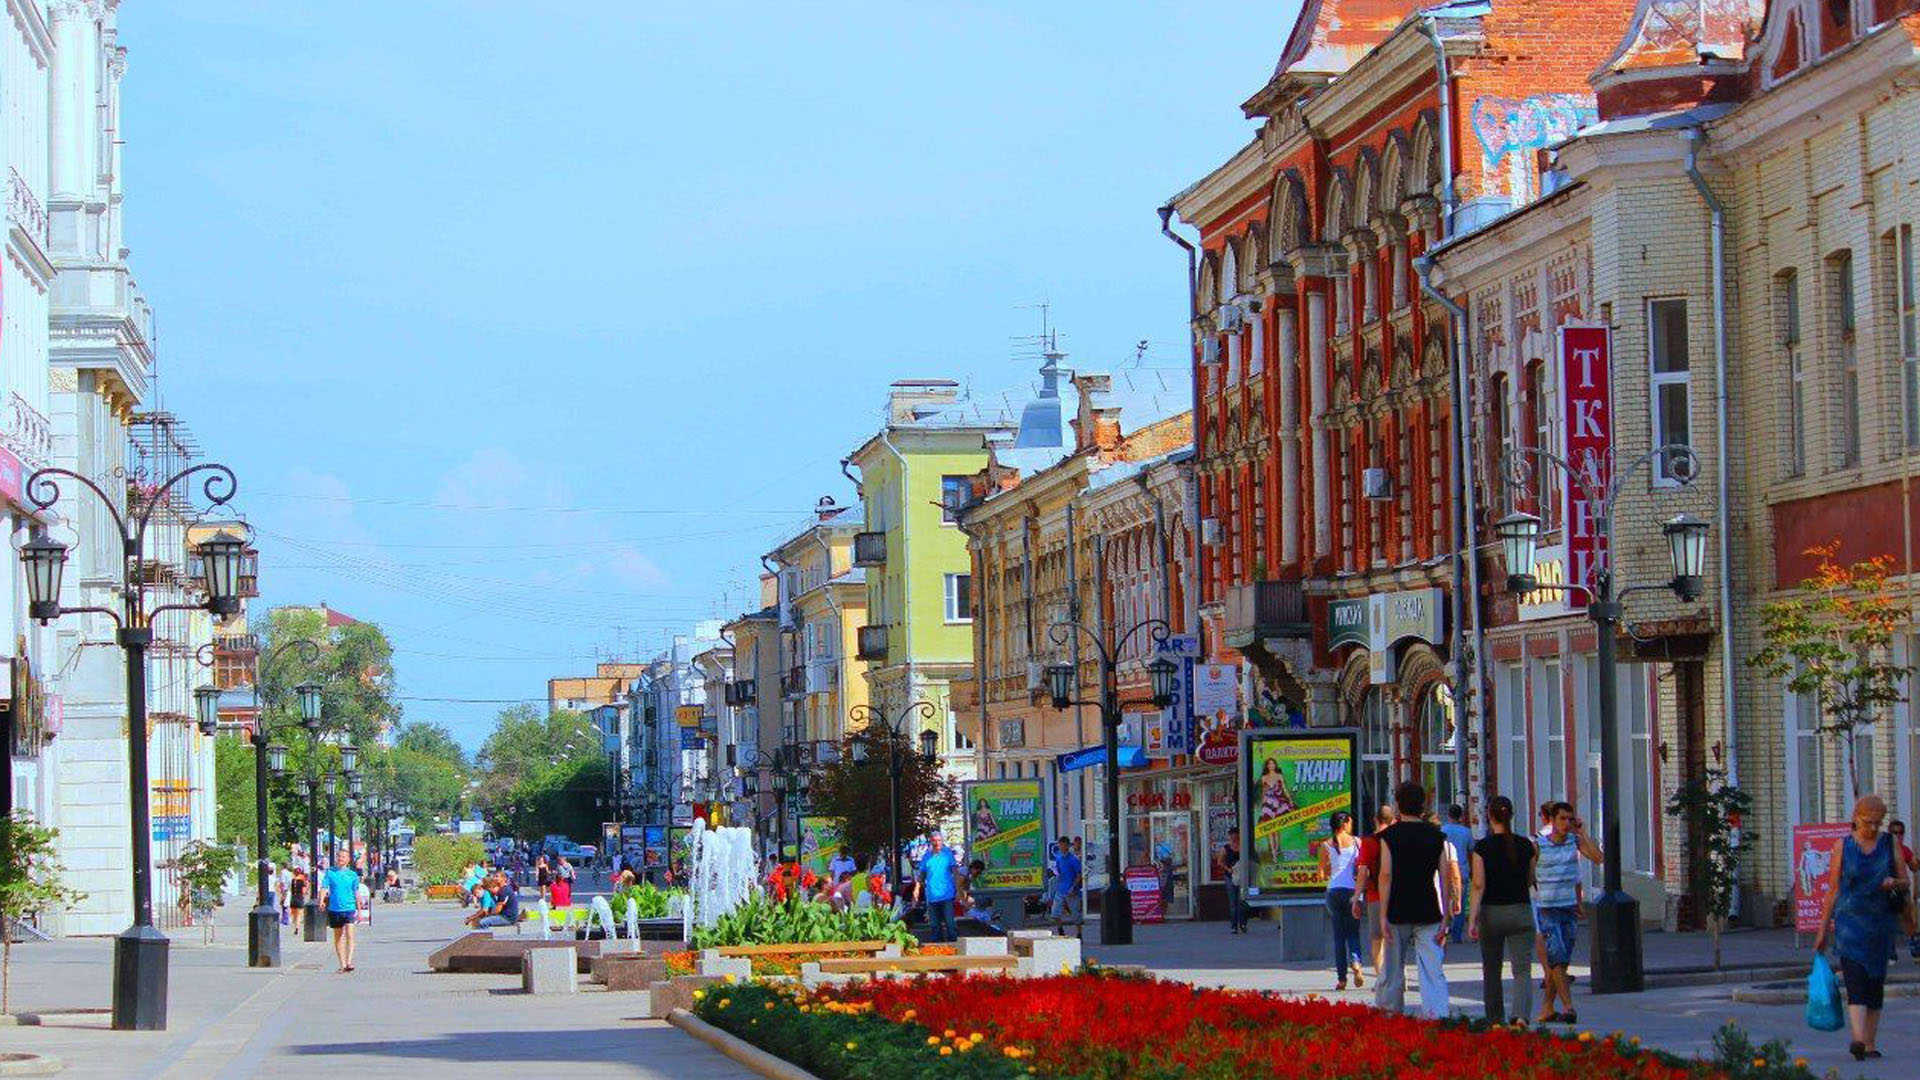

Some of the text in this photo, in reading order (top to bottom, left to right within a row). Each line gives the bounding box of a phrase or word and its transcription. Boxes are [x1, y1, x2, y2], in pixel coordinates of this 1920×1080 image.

[1573, 348, 1608, 588] ТКАНИ
[1294, 759, 1346, 784] ТКАНИ
[1000, 799, 1035, 816] ТКАНИ
